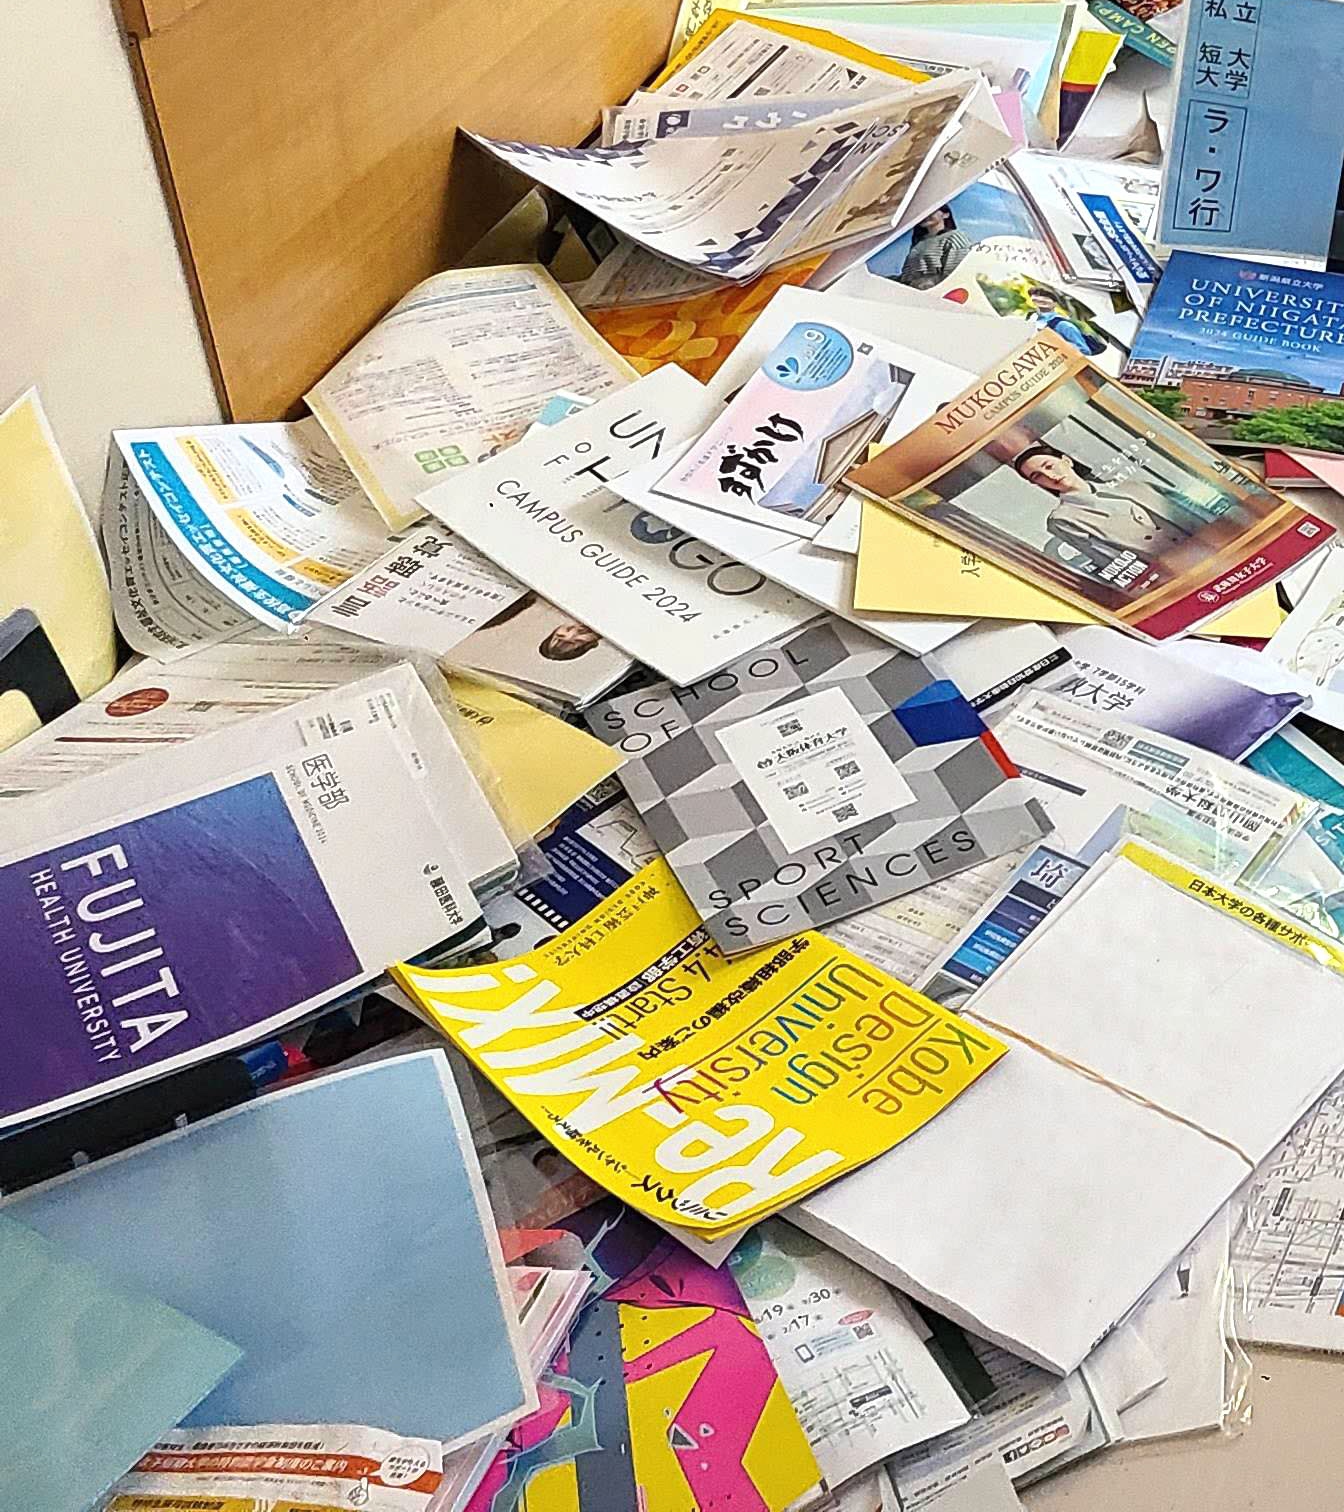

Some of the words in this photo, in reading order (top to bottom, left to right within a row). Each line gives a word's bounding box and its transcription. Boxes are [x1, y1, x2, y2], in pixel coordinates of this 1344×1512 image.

[1188, 107, 1229, 227] ラ・ワ行
[1184, 293, 1227, 311] OF
[1259, 272, 1324, 292] 新潟県立大学
[1232, 329, 1278, 345] GUIDE
[1280, 336, 1322, 353] BOOK
[933, 340, 1062, 437] MUKOGAWA
[496, 479, 582, 545] CAMPUS
[579, 540, 646, 593] GUIDE
[641, 585, 702, 625] 2024
[603, 647, 810, 732] SCHOOL
[621, 717, 679, 753] OF
[300, 753, 351, 812] 医学部
[707, 832, 862, 912] SPORT
[724, 828, 976, 938] SCIENCES
[28, 867, 76, 946] HEALTH
[58, 943, 124, 1066] UNIVERSITY
[59, 841, 194, 1055] FUJITA
[652, 960, 881, 1115] University
[787, 990, 903, 1106] Design
[862, 1024, 990, 1116] Kobe
